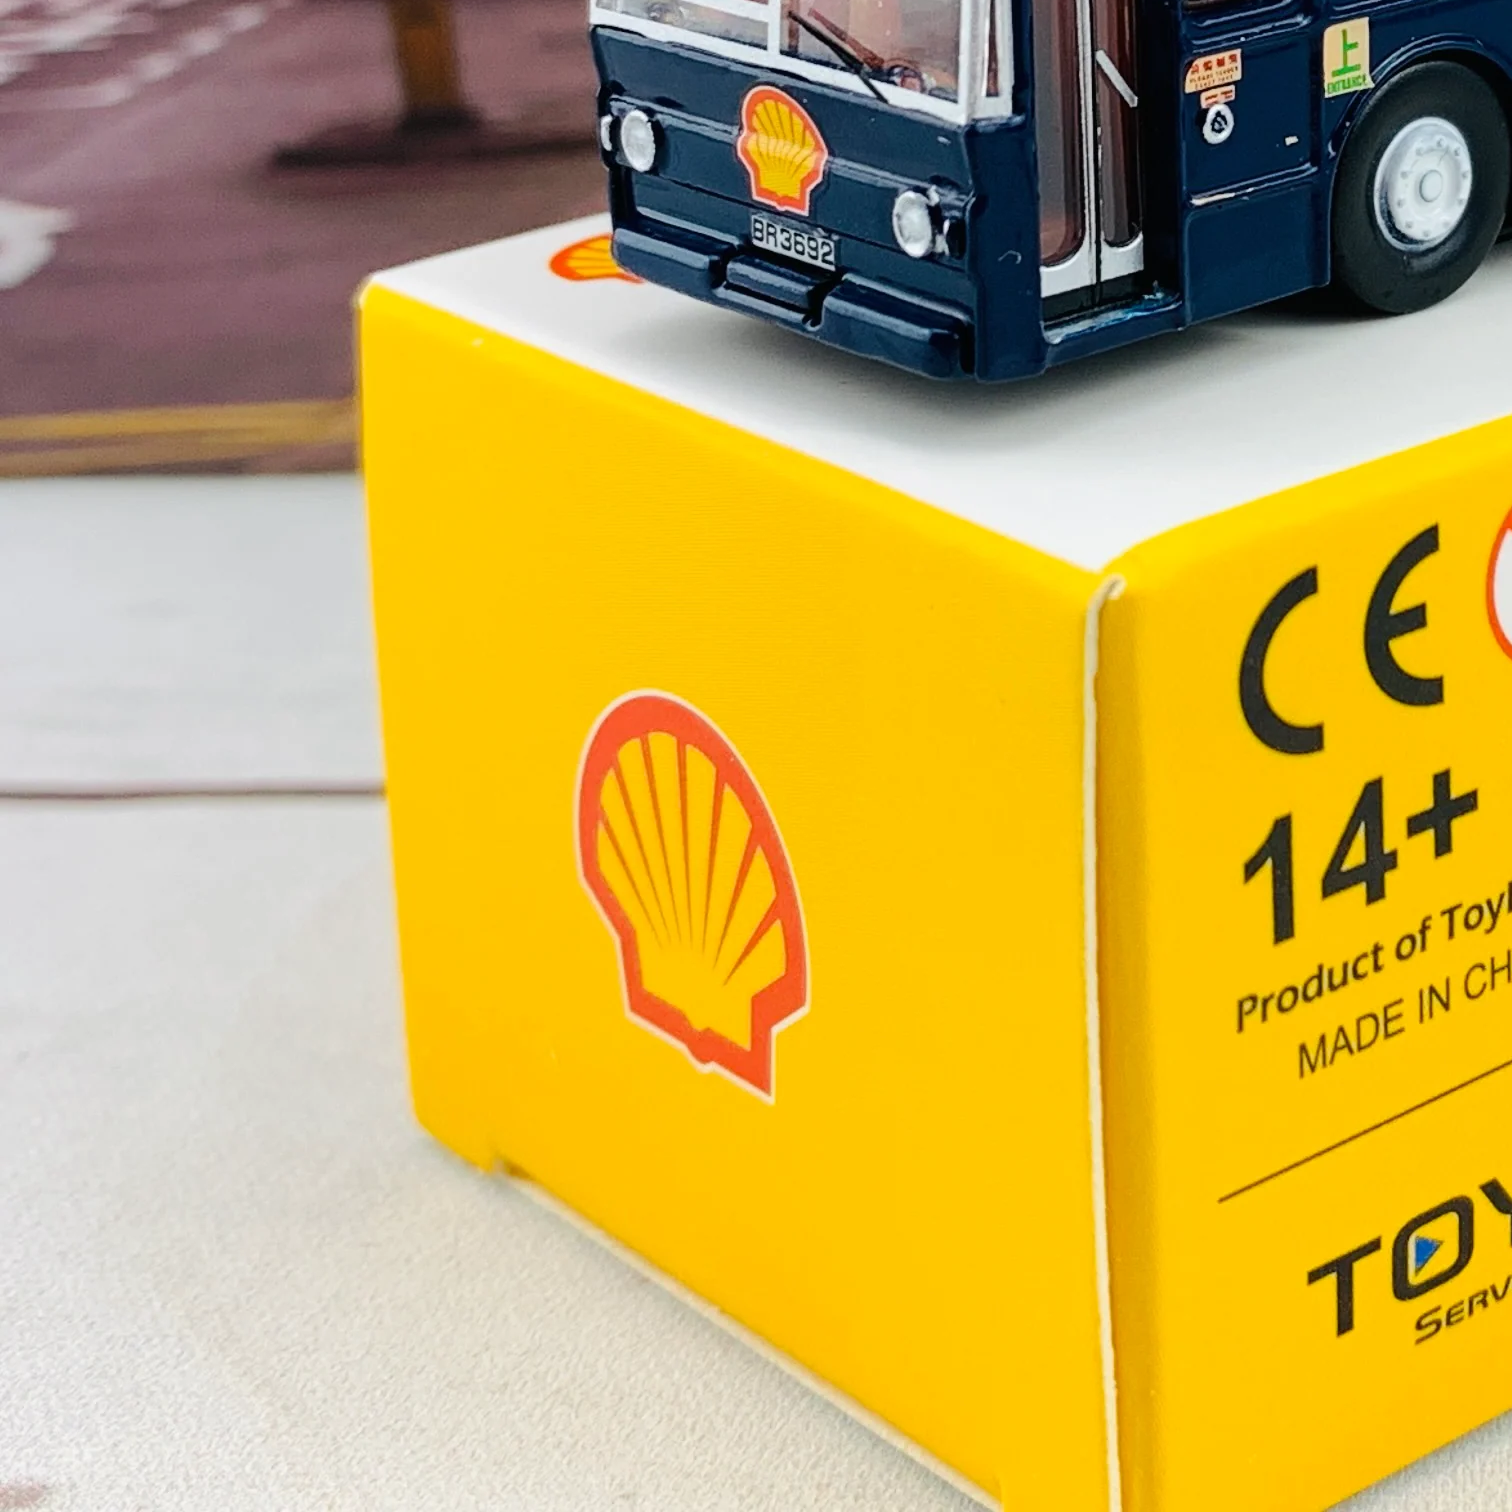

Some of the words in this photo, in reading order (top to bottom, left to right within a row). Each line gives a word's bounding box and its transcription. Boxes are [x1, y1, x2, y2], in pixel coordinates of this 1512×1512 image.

[1331, 28, 1362, 78] 上
[751, 217, 835, 267] BR3692
[1239, 522, 1444, 755] CE
[1243, 768, 1479, 945] 14+
[1236, 940, 1385, 1034] Product
[1395, 915, 1433, 961] of
[1298, 998, 1405, 1080] MADE
[1417, 974, 1452, 1025] IN
